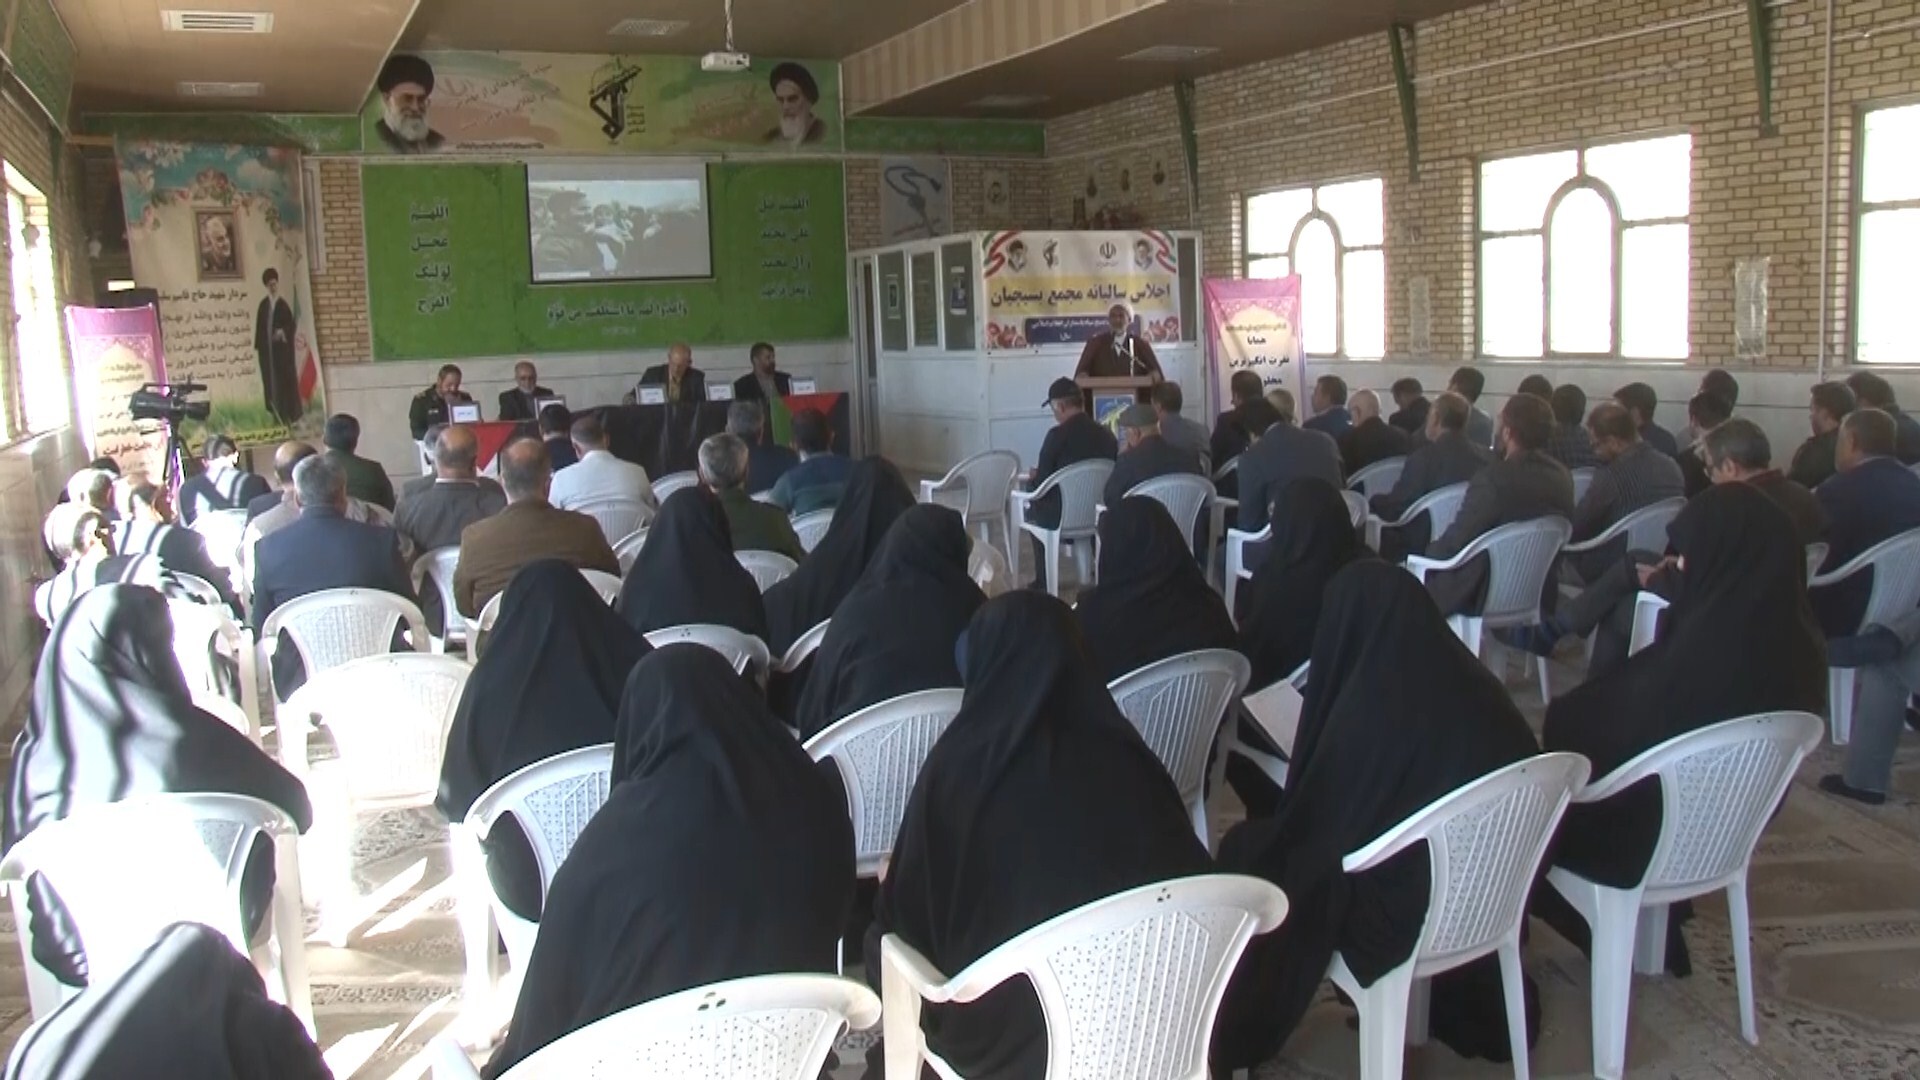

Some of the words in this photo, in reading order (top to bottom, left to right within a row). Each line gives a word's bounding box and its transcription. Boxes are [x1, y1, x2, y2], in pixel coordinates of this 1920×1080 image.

[191, 289, 207, 303] حاج
[228, 289, 248, 302] سردار
[990, 285, 1044, 308] بسیجیان
[1047, 288, 1084, 306] مجمع
[1086, 283, 1127, 301] سالیانه
[1130, 283, 1171, 303] اجلاس
[1263, 375, 1283, 388] مخلو
